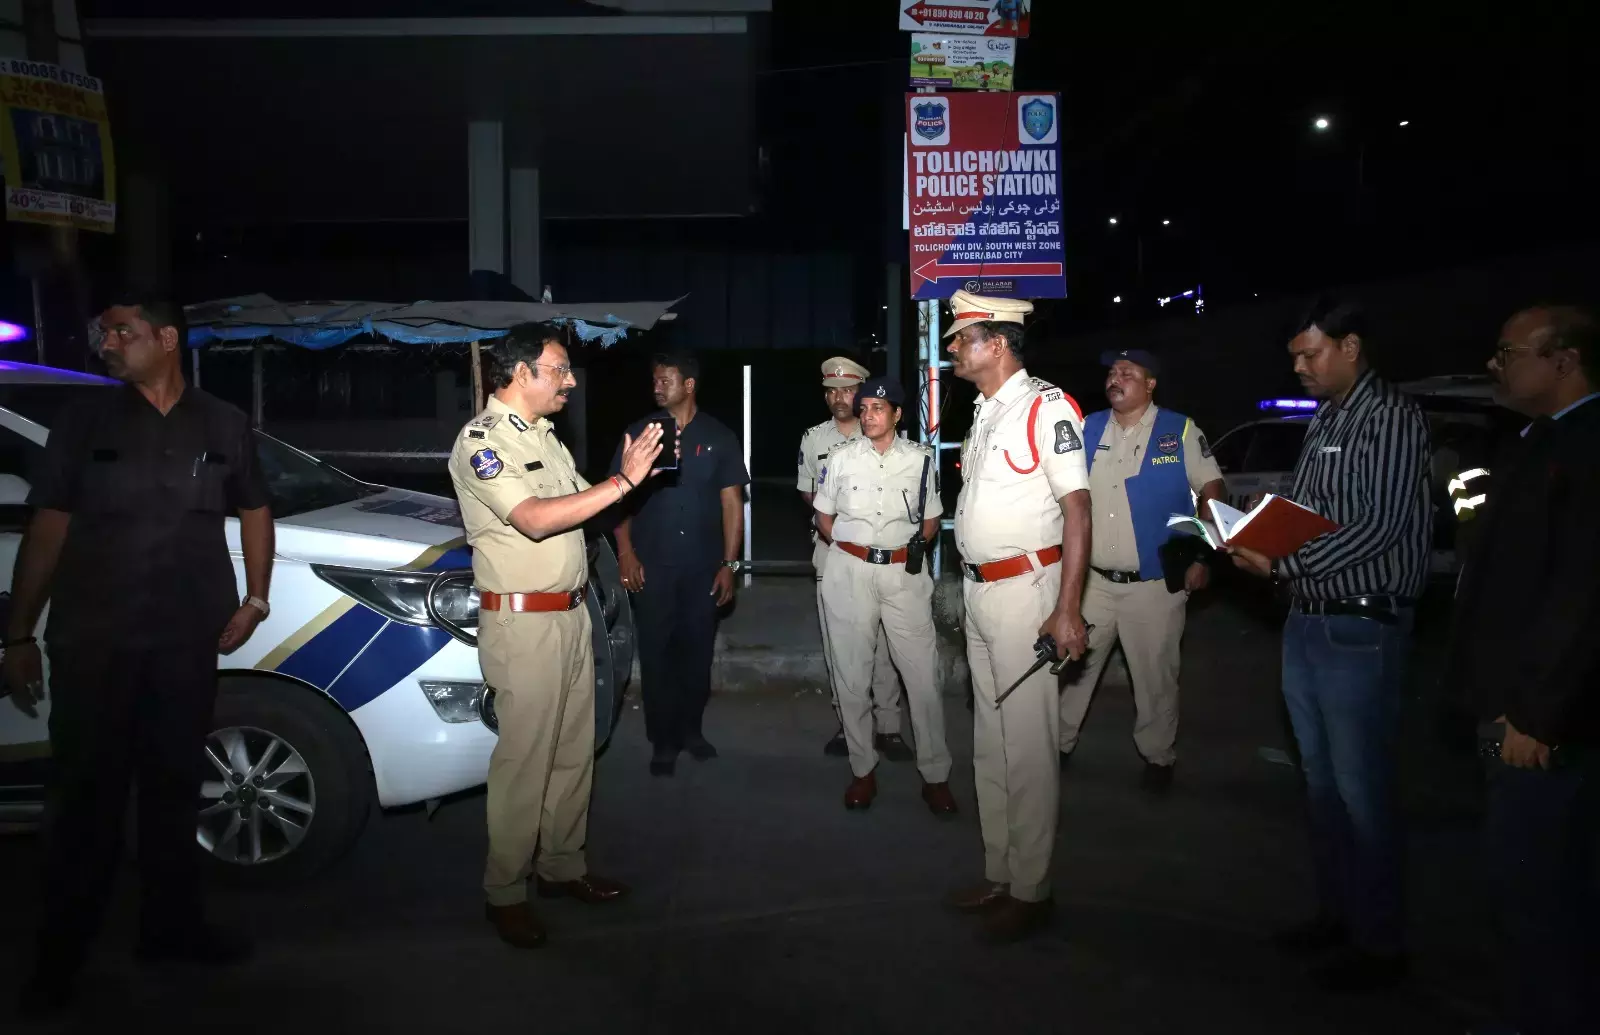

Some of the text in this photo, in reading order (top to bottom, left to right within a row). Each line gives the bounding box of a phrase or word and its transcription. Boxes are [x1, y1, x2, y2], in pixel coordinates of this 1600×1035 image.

[932, 8, 947, 18] 890
[948, 9, 963, 19] 890
[974, 11, 985, 20] 20
[60, 68, 98, 90] 67509
[913, 149, 1056, 173] TOLICHOWKI
[916, 174, 1057, 197] POLICE STATION
[913, 198, 1060, 216] ٹولی چوکی پولیس اسٹیشن
[914, 242, 1061, 252] TOLICHOWKI DIV. SOUTH WEST ZONE
[952, 251, 1023, 260] HYDERABAD CITY
[1151, 455, 1181, 466] PATROL
